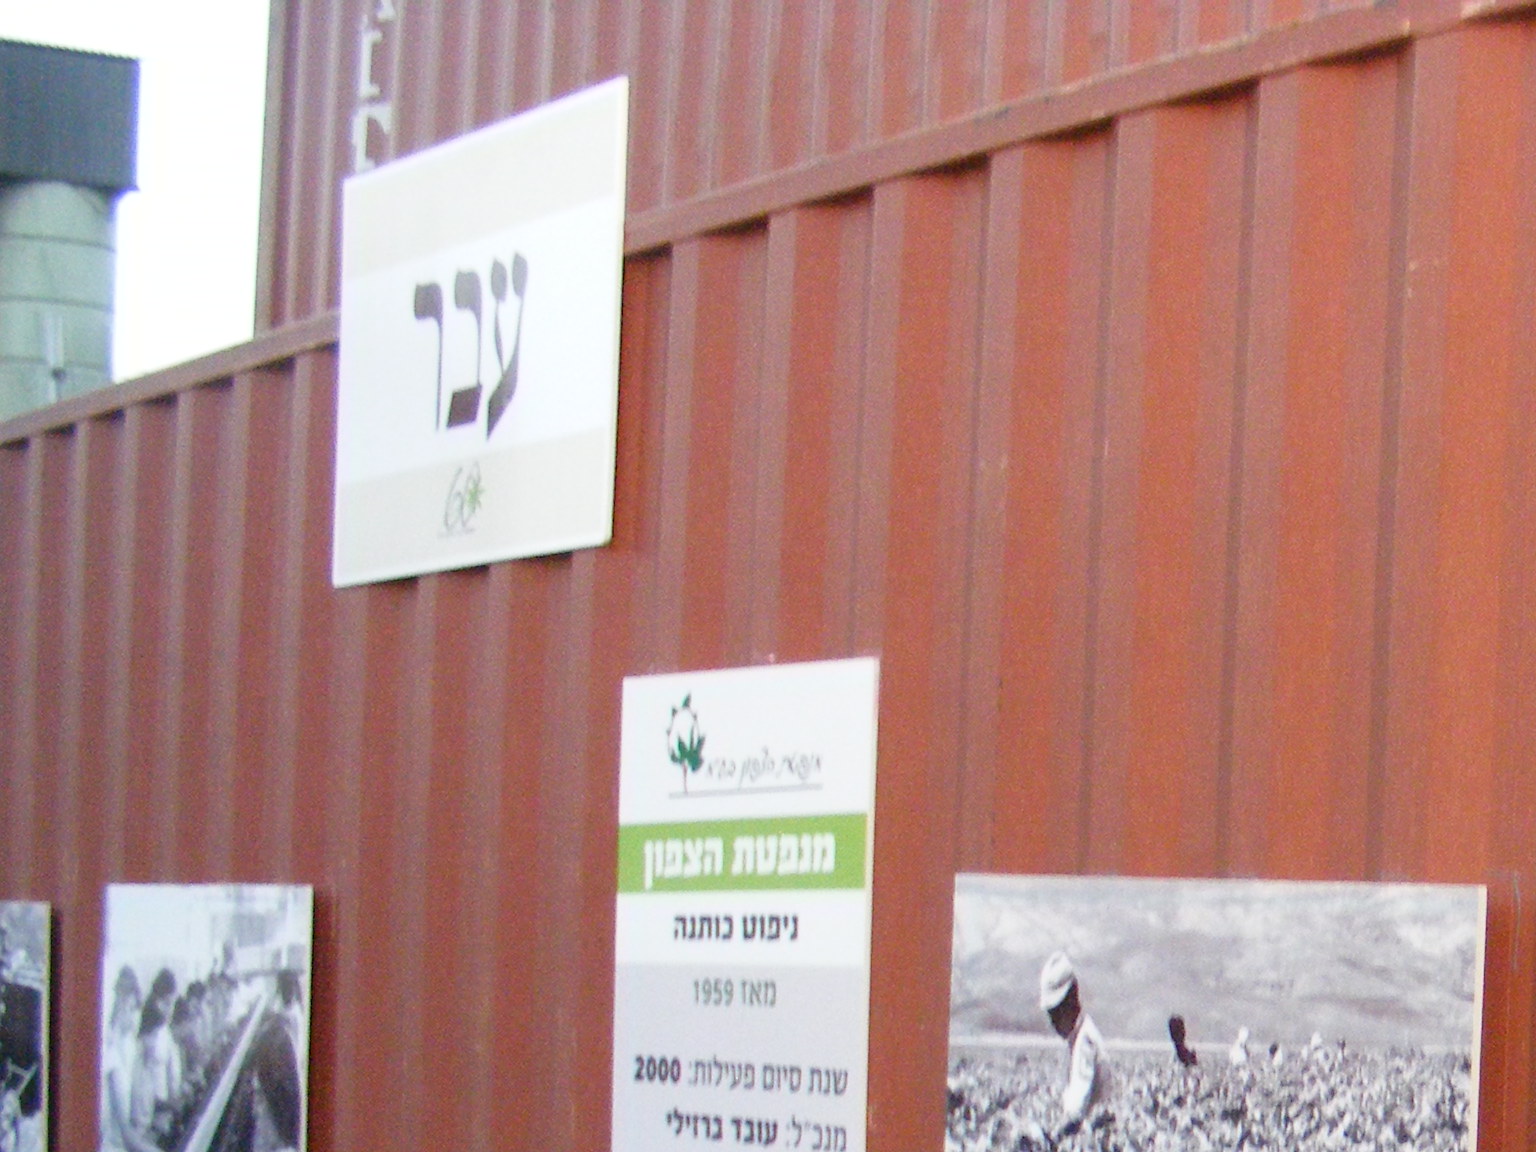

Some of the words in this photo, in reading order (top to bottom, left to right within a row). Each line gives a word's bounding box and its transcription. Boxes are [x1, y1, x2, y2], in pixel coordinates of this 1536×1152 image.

[413, 252, 529, 442] עבר
[643, 836, 724, 891] הצפון
[731, 832, 836, 876] מנפטת
[673, 914, 733, 941] כותנה
[742, 914, 799, 941] ניפוט
[694, 977, 734, 1007] 1959
[741, 979, 777, 1007] מאז
[634, 1055, 681, 1082] 2000
[762, 1063, 802, 1093] סיום
[808, 1067, 848, 1096] שנת
[666, 1106, 723, 1141] ברזילי
[731, 1116, 778, 1146] עובד
